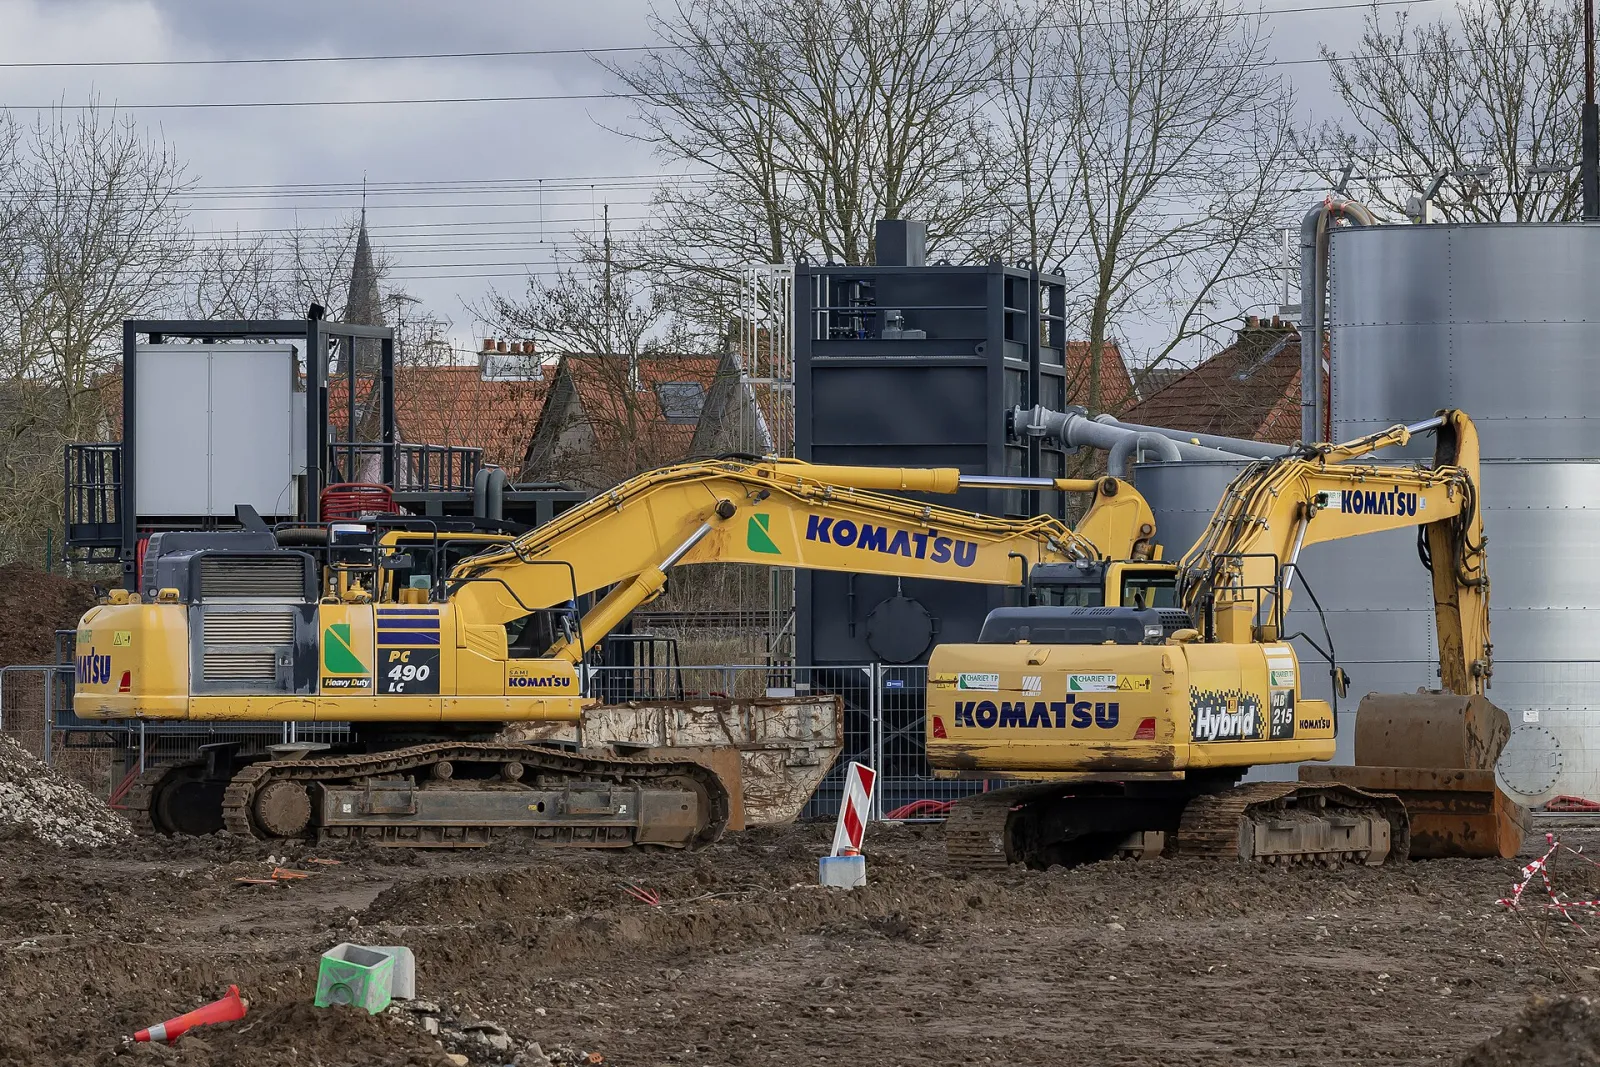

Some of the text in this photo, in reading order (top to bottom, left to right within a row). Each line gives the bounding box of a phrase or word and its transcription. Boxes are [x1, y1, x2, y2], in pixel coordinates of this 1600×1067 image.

[1341, 485, 1417, 516] KOMATSU
[805, 514, 978, 567] KOMATSU
[388, 650, 411, 663] PC
[76, 646, 111, 684] MATSU
[387, 664, 430, 681] 490
[967, 674, 999, 682] CHARIER TP
[1079, 675, 1105, 683] CHARIER
[325, 679, 370, 687] Heavy Duty
[387, 682, 405, 693] LC
[508, 675, 570, 687] KOMATSU
[1273, 694, 1285, 707] HB
[954, 693, 1120, 729] KOMATSU
[1272, 708, 1293, 724] 215
[1195, 705, 1256, 741] Hybrid
[1299, 716, 1331, 729] KOMATSU
[1272, 725, 1281, 736] LC
